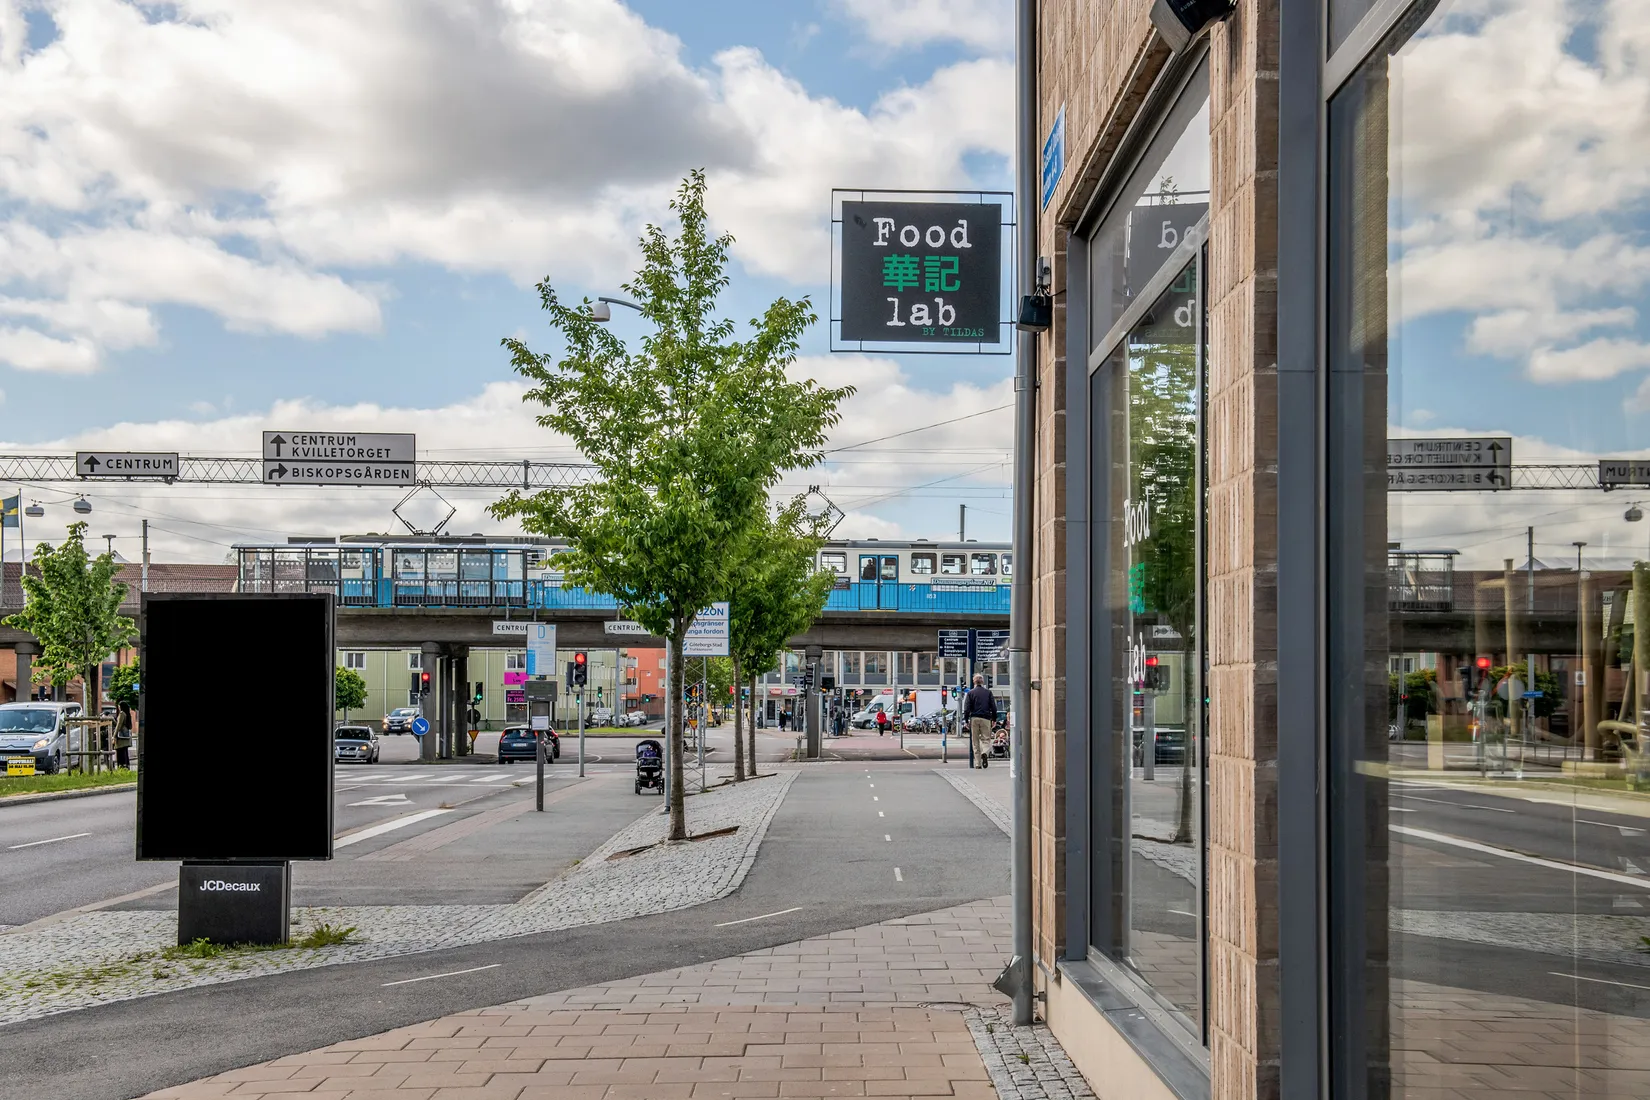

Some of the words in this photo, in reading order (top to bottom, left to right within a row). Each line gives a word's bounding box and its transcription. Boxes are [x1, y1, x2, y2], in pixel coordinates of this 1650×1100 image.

[872, 217, 972, 248] Food
[882, 254, 960, 292] 華記
[886, 297, 956, 326] lab
[922, 328, 936, 336] BY
[944, 328, 984, 336] TILDAS
[292, 435, 356, 446] CENTRUM
[292, 448, 391, 458] KVILLETORGET
[106, 459, 172, 469] CENTRUM
[292, 466, 410, 479] BISKOPSGÅRDEN
[1124, 488, 1150, 547] Food
[1128, 632, 1146, 684] lab
[200, 880, 260, 891] JCDecaux
